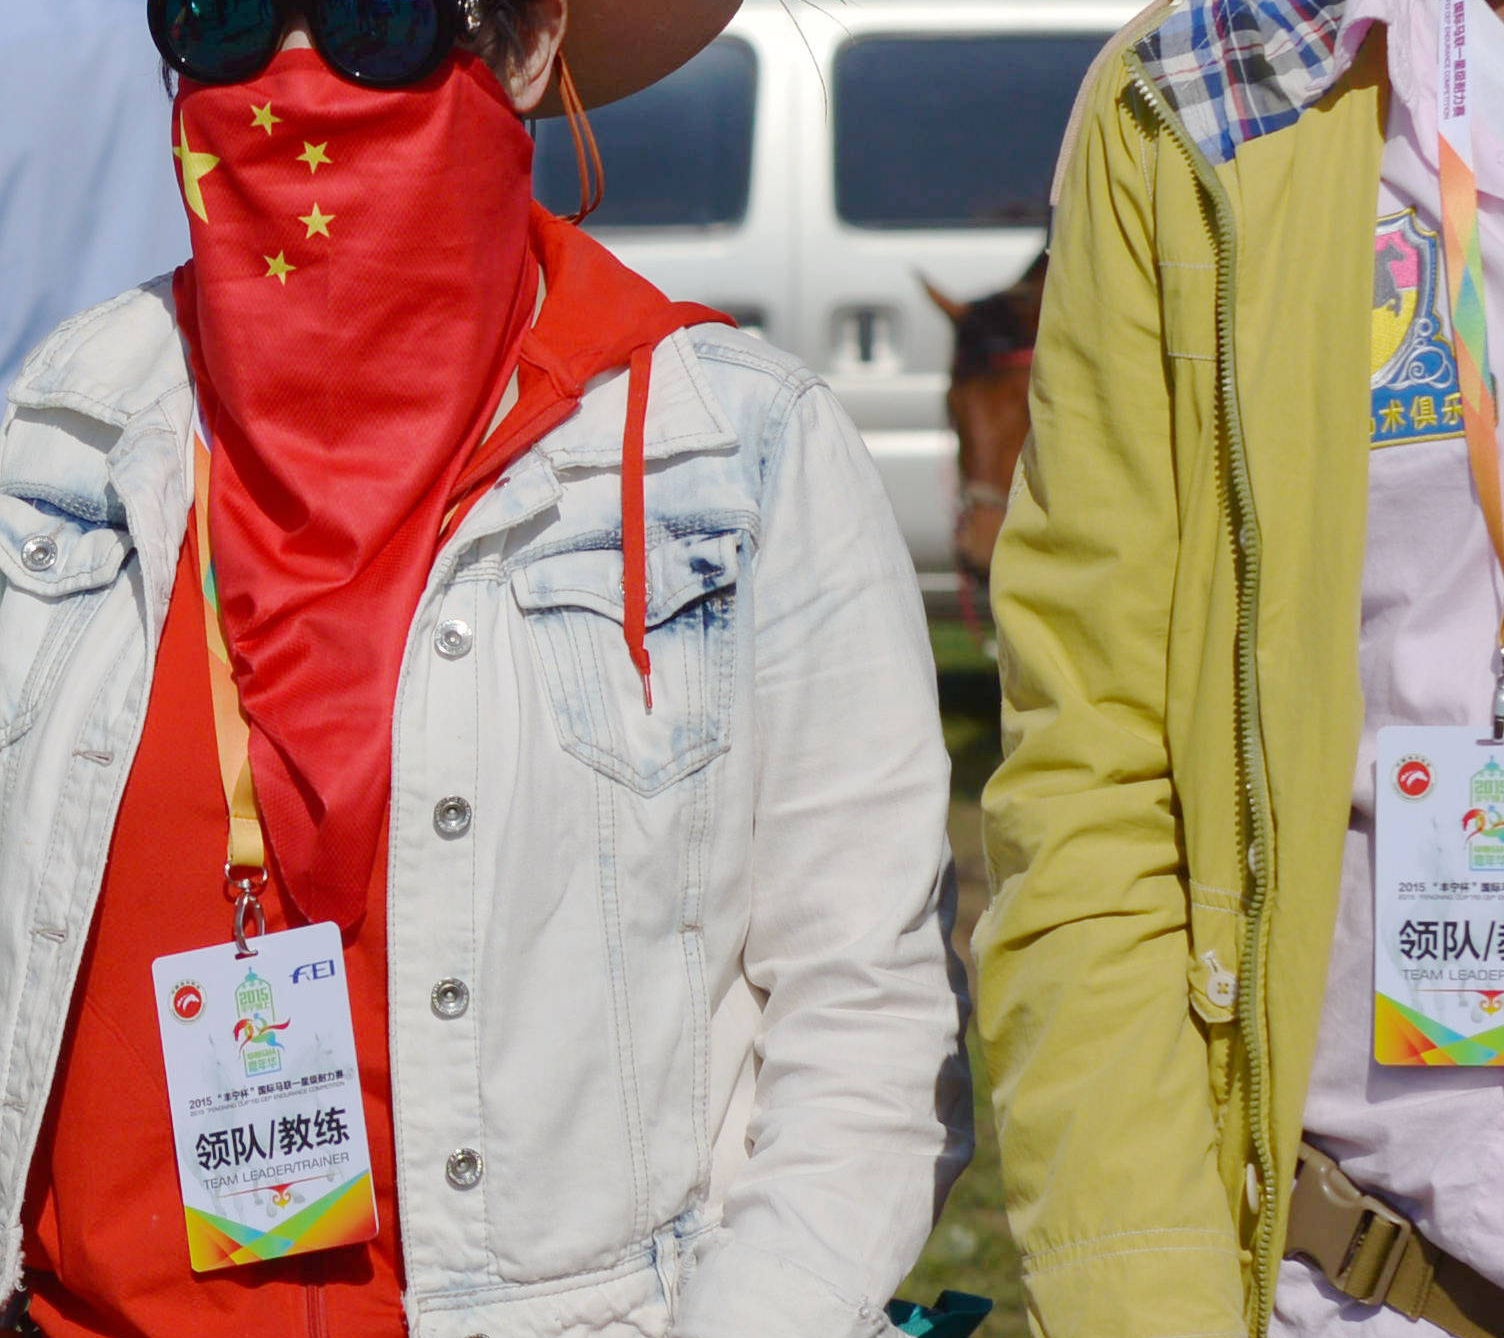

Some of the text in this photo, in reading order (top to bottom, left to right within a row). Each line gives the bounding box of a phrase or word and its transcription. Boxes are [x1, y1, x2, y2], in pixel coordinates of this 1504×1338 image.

[1369, 391, 1464, 437] 术俱乐
[1398, 882, 1426, 893] 2015
[288, 959, 336, 984] FEI
[1402, 969, 1443, 982] TEAM
[238, 987, 269, 1006] 2015
[188, 1096, 213, 1110] 2015
[194, 1107, 351, 1172] 领队/教练
[202, 1152, 351, 1191] TEAM LEADER/TRAINER
